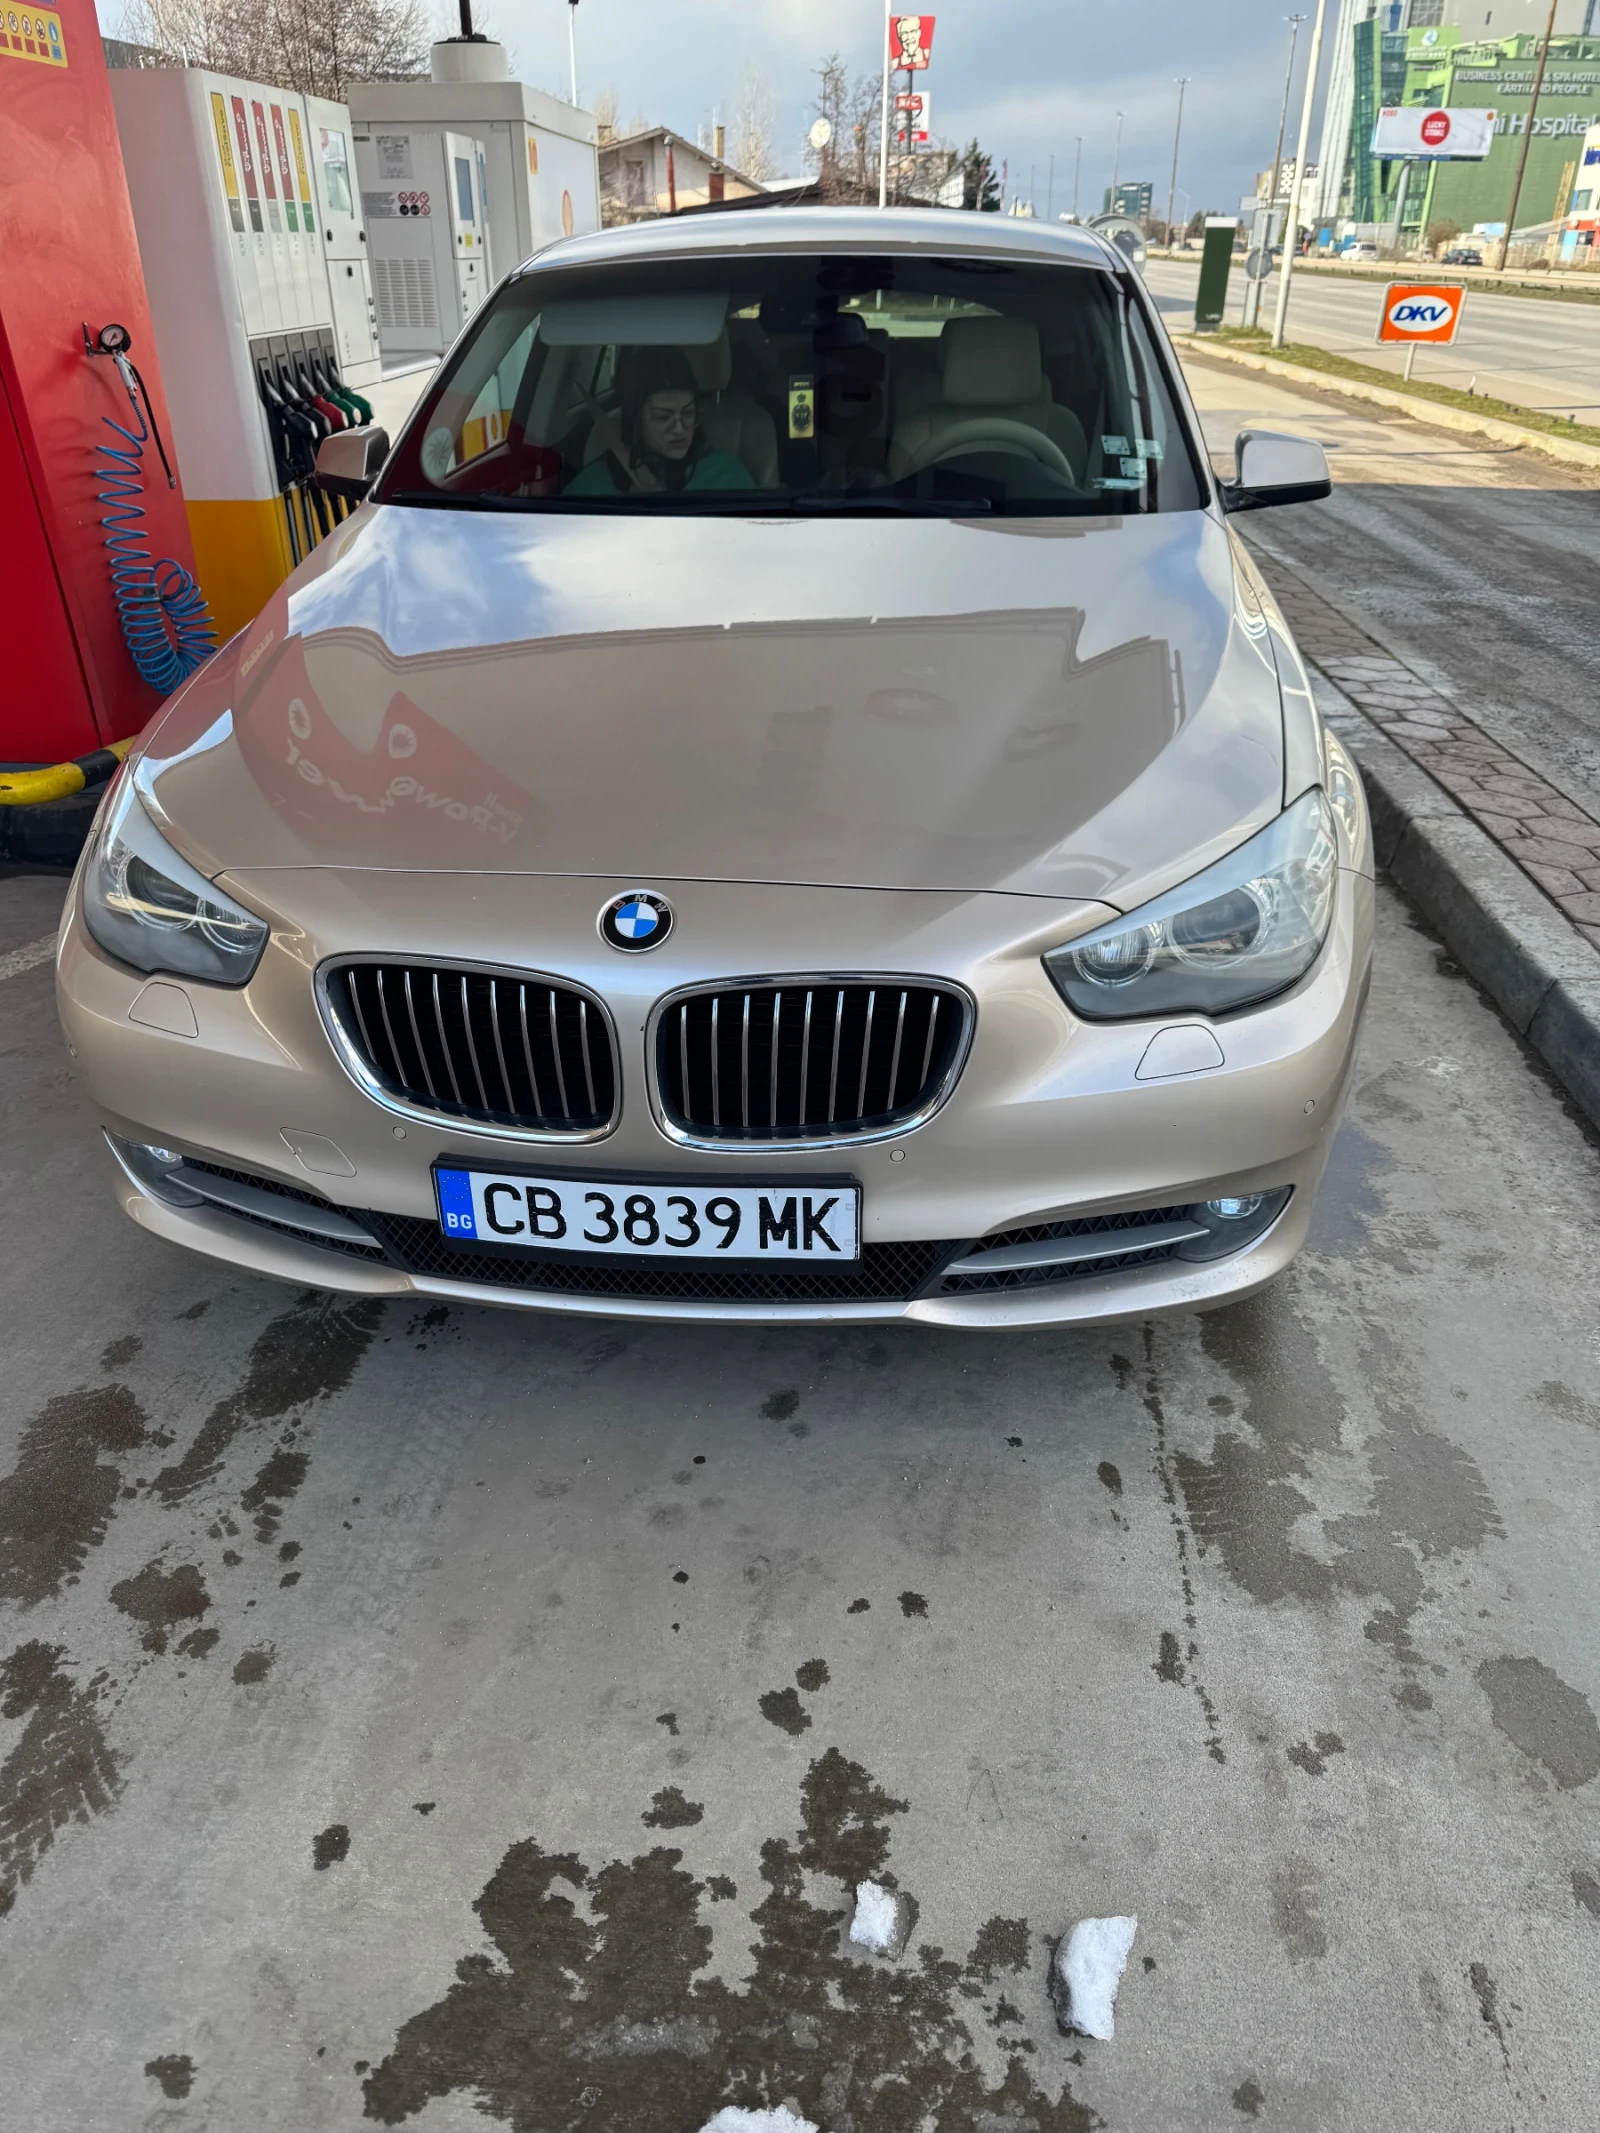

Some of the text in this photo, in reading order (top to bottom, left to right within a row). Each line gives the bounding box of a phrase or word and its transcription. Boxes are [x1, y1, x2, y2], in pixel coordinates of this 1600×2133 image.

[1509, 112, 1597, 140] Hospital
[1392, 305, 1448, 321] DKV
[613, 893, 670, 913] BMW
[447, 1212, 473, 1230] BG
[483, 1182, 843, 1252] CB 3839 MK
